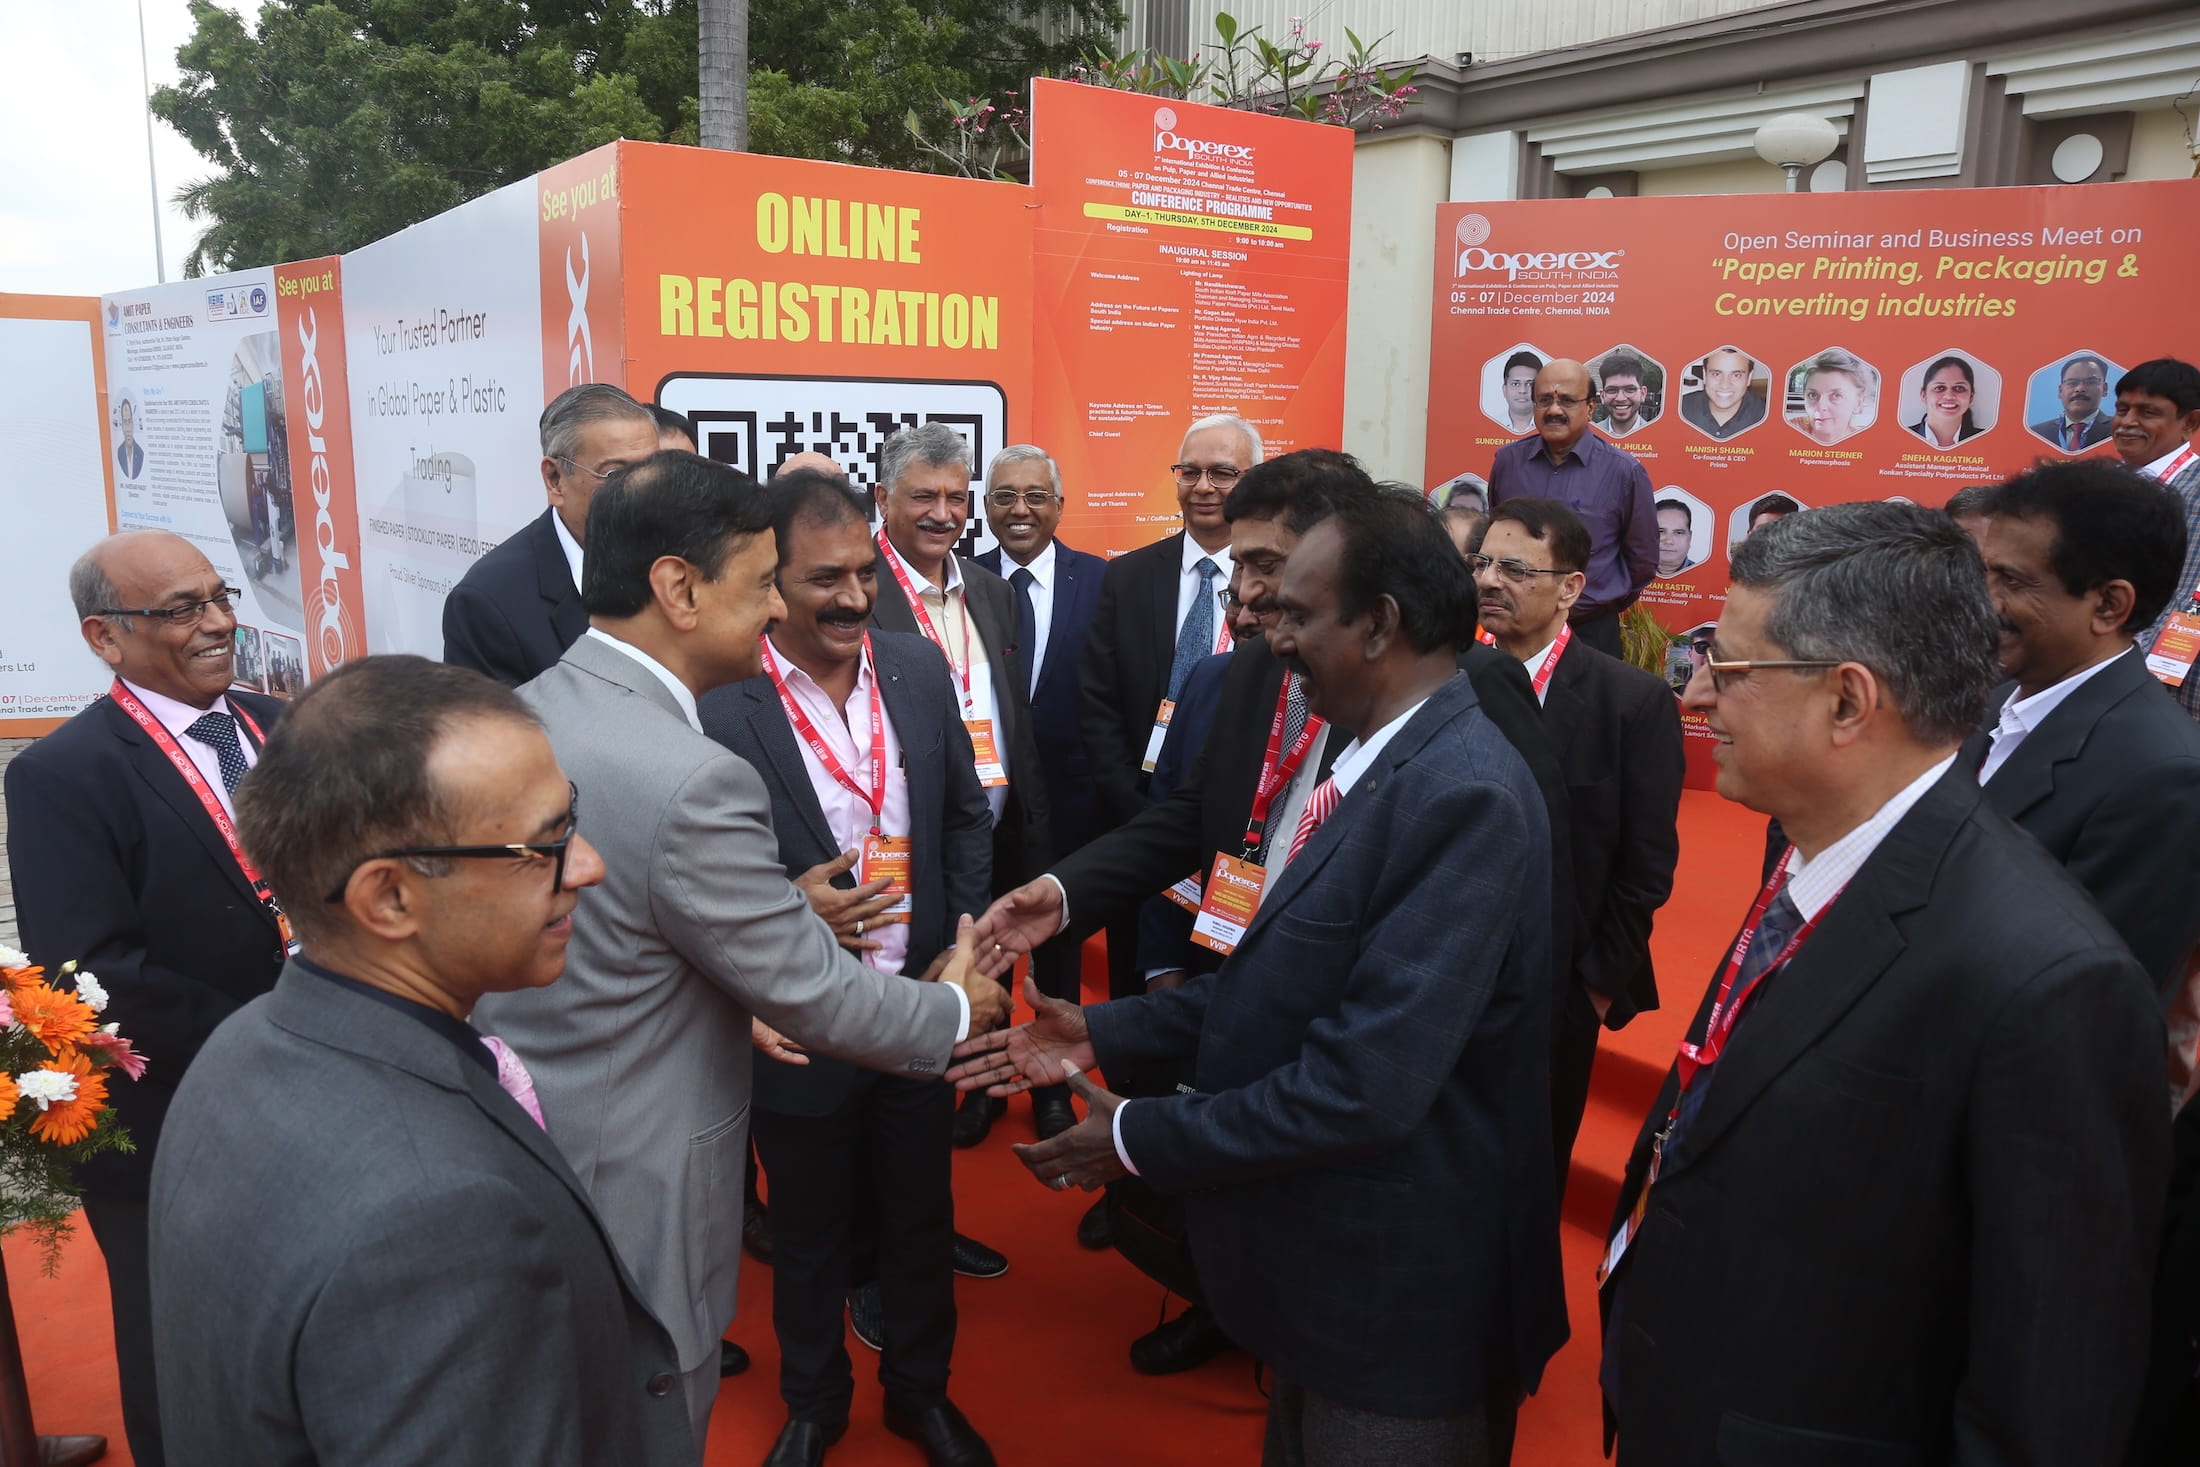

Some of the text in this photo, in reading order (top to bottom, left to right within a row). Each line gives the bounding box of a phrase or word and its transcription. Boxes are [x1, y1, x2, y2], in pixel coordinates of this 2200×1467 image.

[1194, 152, 1253, 166] SOUTH INDIA
[1118, 169, 1285, 197] 05 07 December 2024 Chennai Trade Centre, Chennai
[542, 164, 617, 223] See you at
[1131, 190, 1272, 220] CONFERENCE PROGRAMME
[756, 191, 921, 265] ONLINE
[1106, 222, 1148, 233] Registration
[1154, 212, 1198, 224] THURSDAY,
[1200, 217, 1215, 226] 5TH
[1217, 219, 1259, 231] DECEMBER
[1261, 224, 1277, 233] 2024
[1724, 226, 2141, 253] Open Seminar and Business Meet on
[1159, 244, 1247, 261] INAUGURAL SESSION
[1520, 270, 1618, 279] SOUTH INDIA
[1712, 253, 2138, 285] “Paper Printing, Packaging &
[278, 271, 333, 300] See you at
[1450, 291, 1615, 303] 05 07 December 2024
[659, 273, 999, 350] REGISTRATION
[1450, 306, 1610, 315] Chennai Trade Centre, Chennai, INDIA
[1714, 292, 2016, 321] Converting industries
[374, 307, 486, 357] Your Trusted Partner
[368, 373, 506, 427] in Global Paper & Plastic
[1475, 438, 1504, 446] SUNDER
[1622, 443, 1653, 451] JHULKA
[1685, 445, 1754, 454] MANISH SHARMA
[1789, 449, 1862, 459] MARION STERNER
[1901, 453, 1984, 464] SNEHA KAGATIKAR
[410, 444, 452, 494] Trading
[1926, 463, 1956, 471] Manager
[1904, 470, 1934, 478] Specialty
[1935, 471, 1979, 479] Polyproducts
[436, 531, 456, 551] PAPER
[1665, 583, 1695, 592] SASTRY
[1546, 652, 1557, 666] BTG
[17, 662, 35, 672] Ltd
[24, 694, 89, 703] December
[17, 705, 44, 713] Trade
[1273, 711, 1283, 729] BTG
[1295, 731, 1310, 749] BTG
[1258, 761, 1270, 793] INPAPER
[1172, 892, 1189, 905] VVIP
[1209, 939, 1228, 951] VVIP
